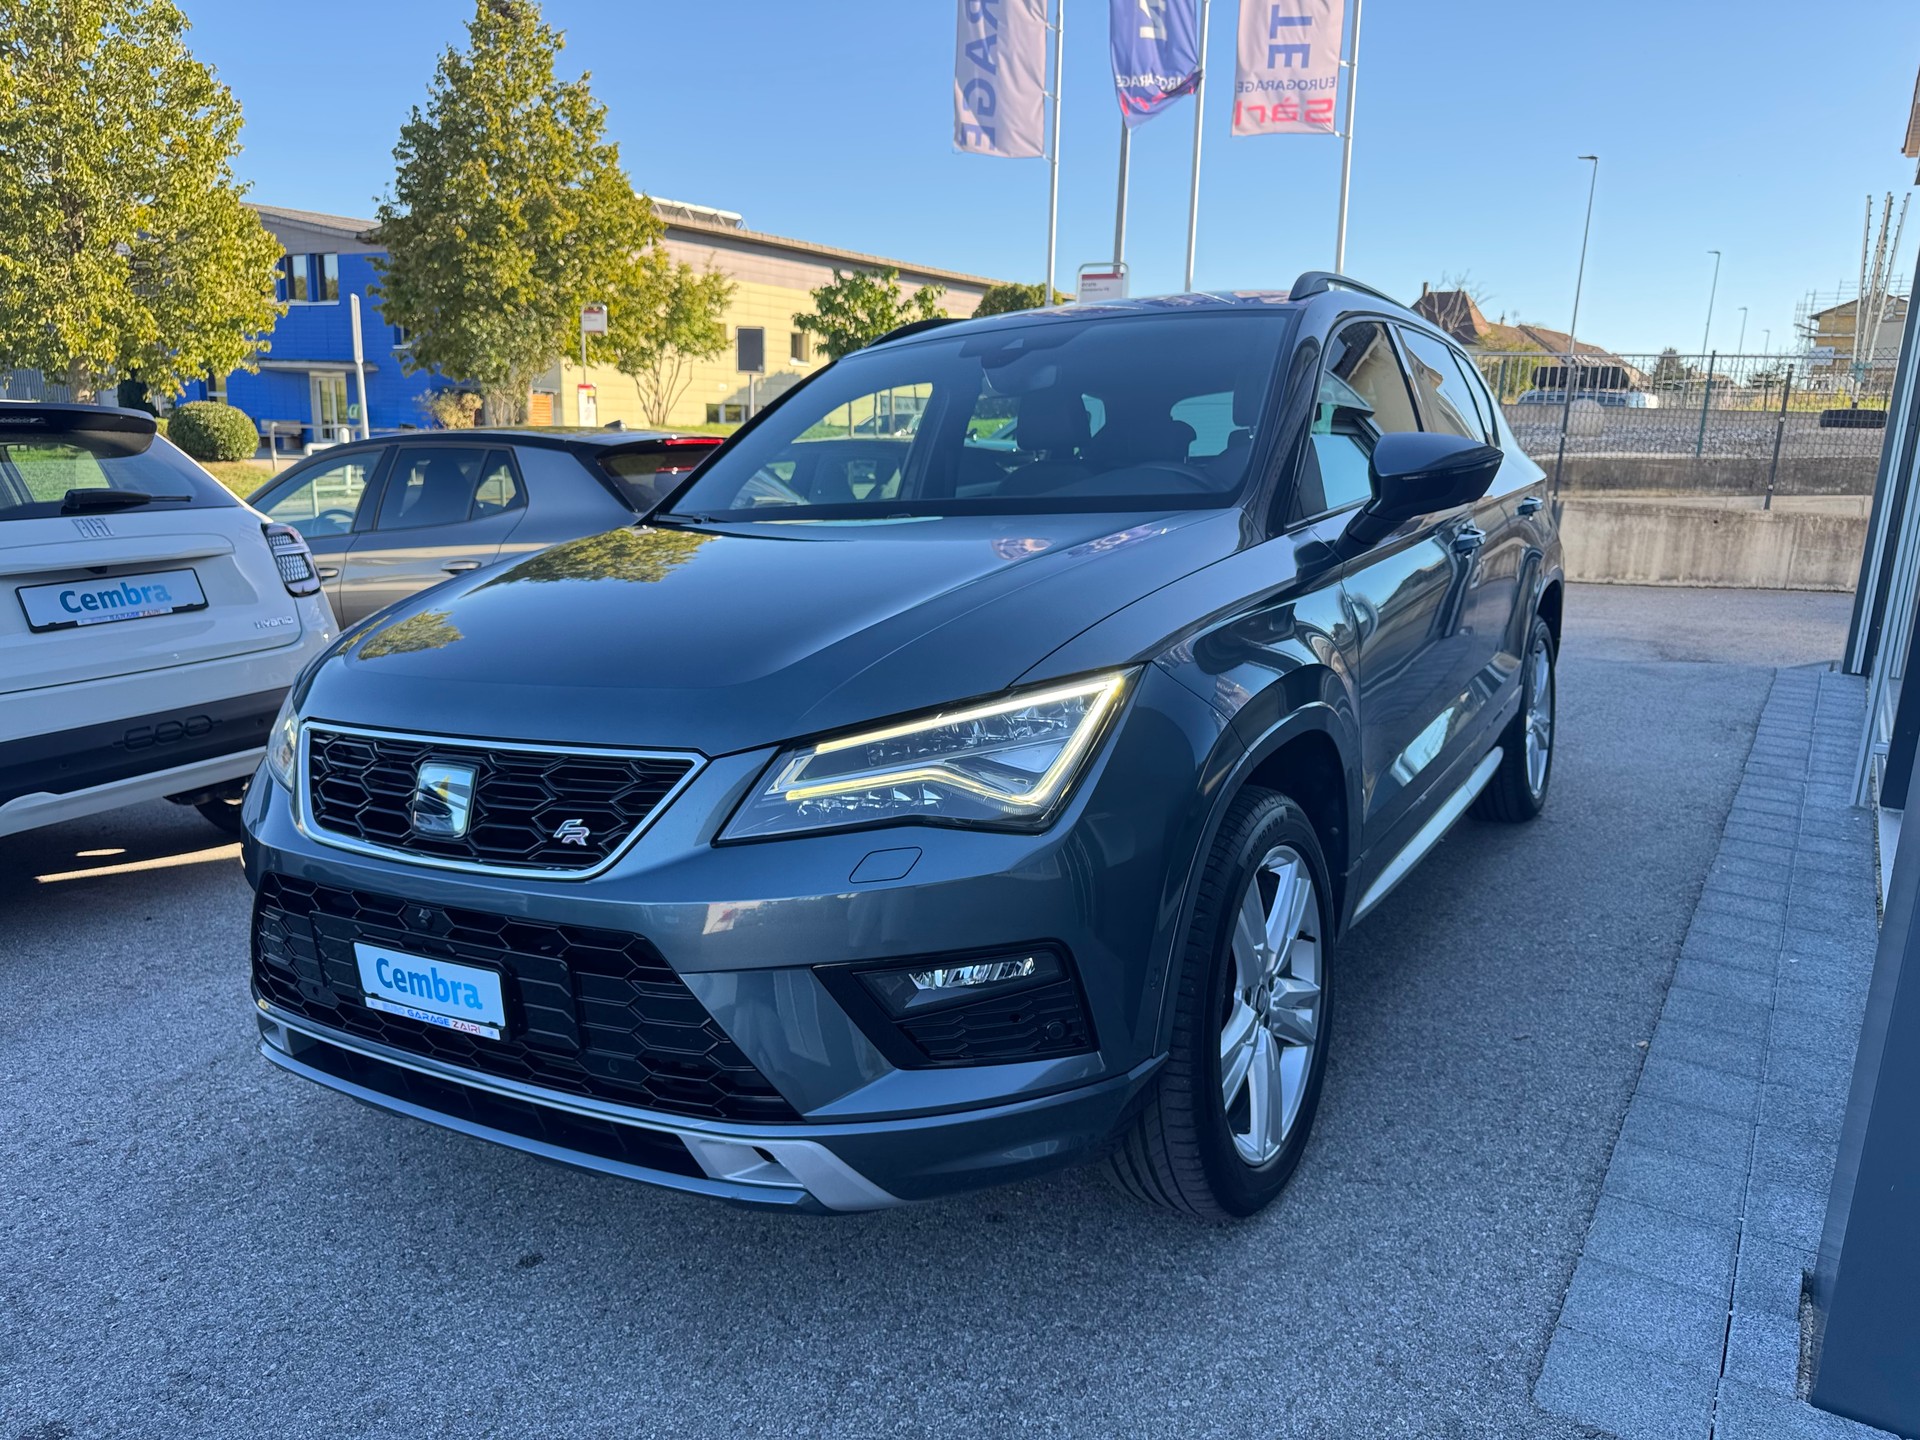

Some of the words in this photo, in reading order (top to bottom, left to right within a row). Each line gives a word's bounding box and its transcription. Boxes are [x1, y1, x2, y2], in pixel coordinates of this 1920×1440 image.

[71, 517, 115, 538] FIAT
[59, 582, 173, 614] Cembra
[553, 818, 590, 846] FR
[375, 957, 484, 1010] Cembra
[407, 1009, 451, 1027] GARAGE
[452, 1020, 482, 1034] ZAIRI
